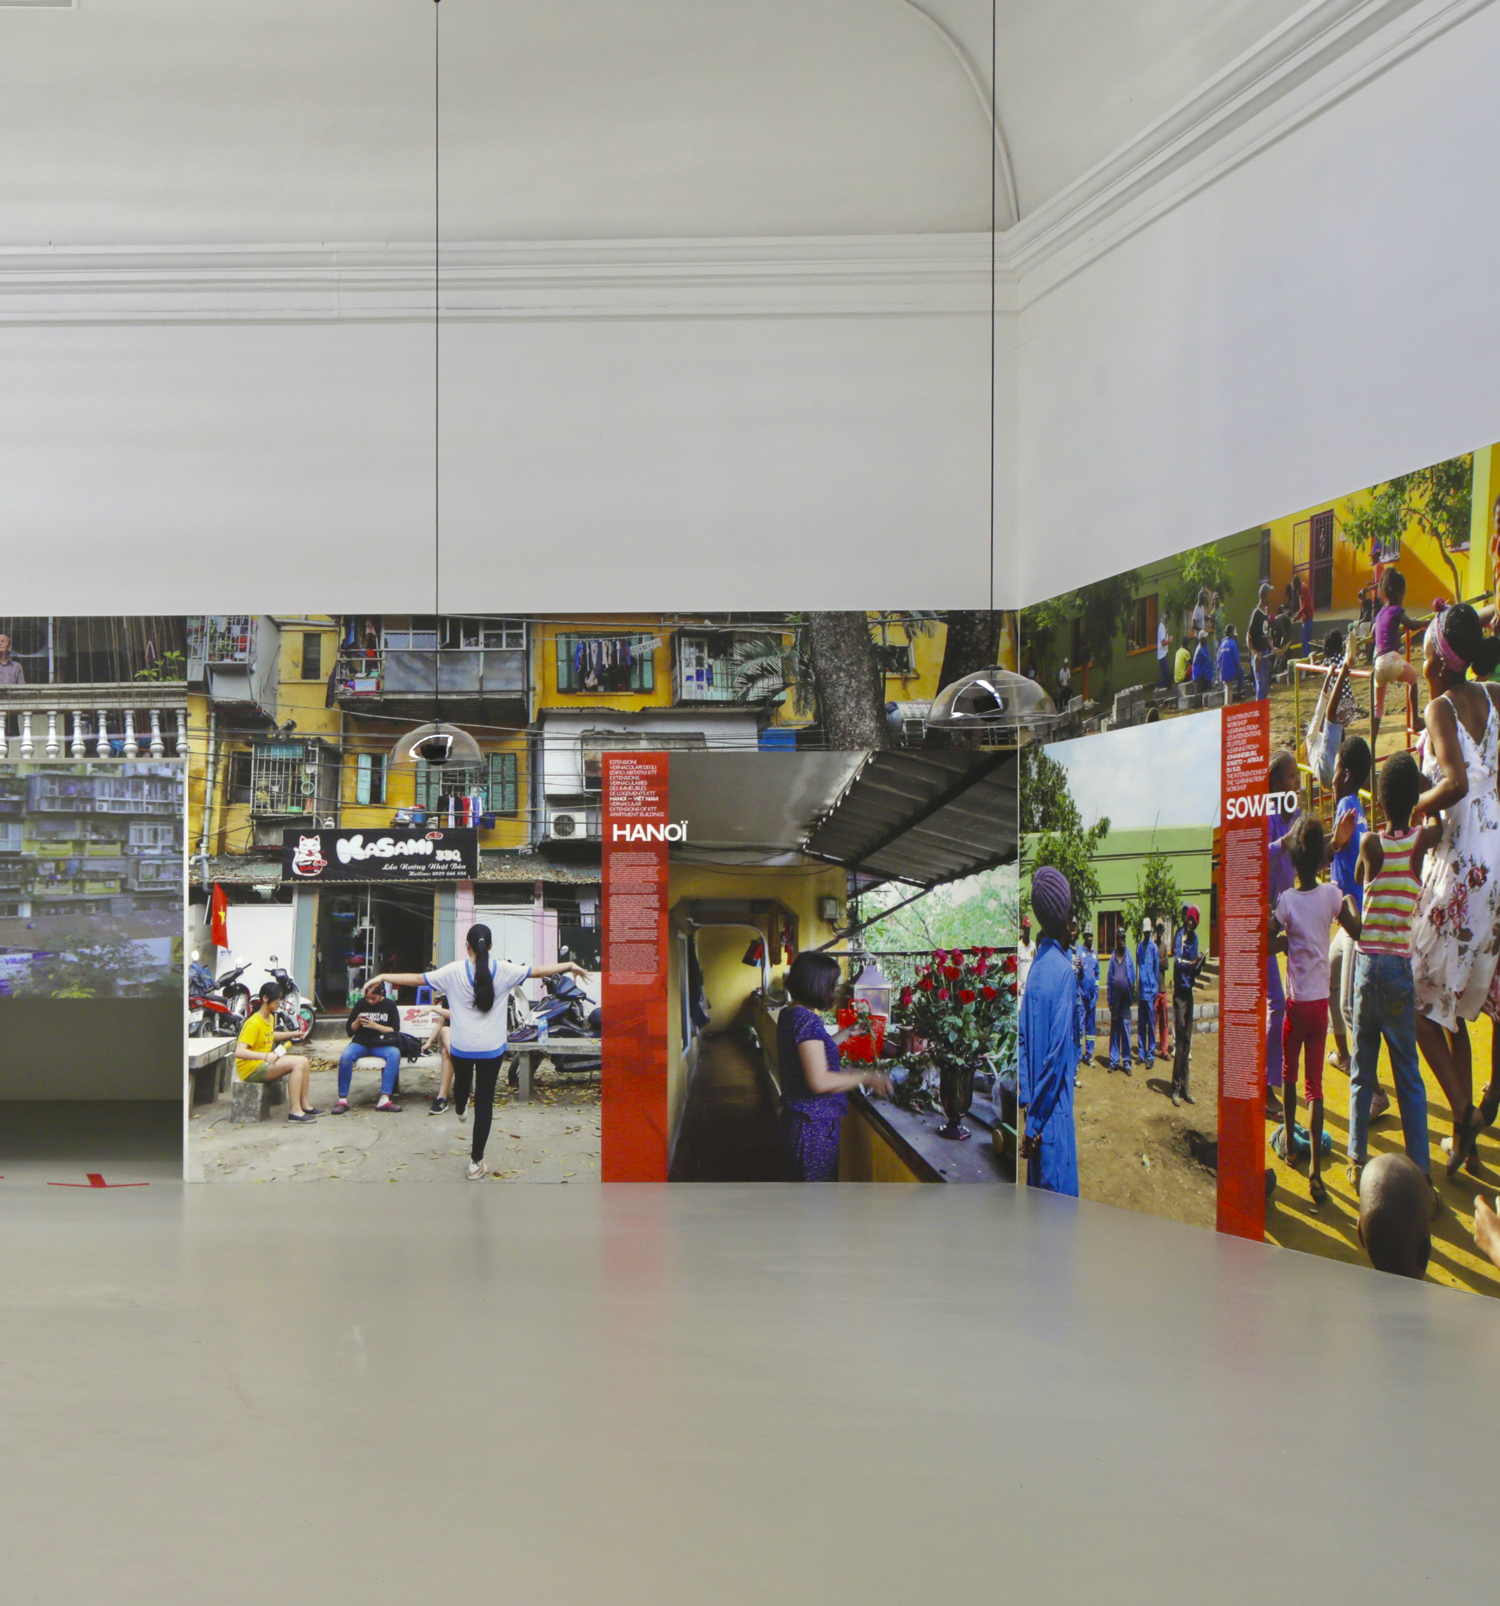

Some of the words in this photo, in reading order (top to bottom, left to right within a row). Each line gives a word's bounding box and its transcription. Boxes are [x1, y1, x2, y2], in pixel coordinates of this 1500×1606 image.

[1226, 791, 1298, 820] SOWETO
[612, 820, 688, 842] HANOÏ
[435, 850, 462, 862] BBQ
